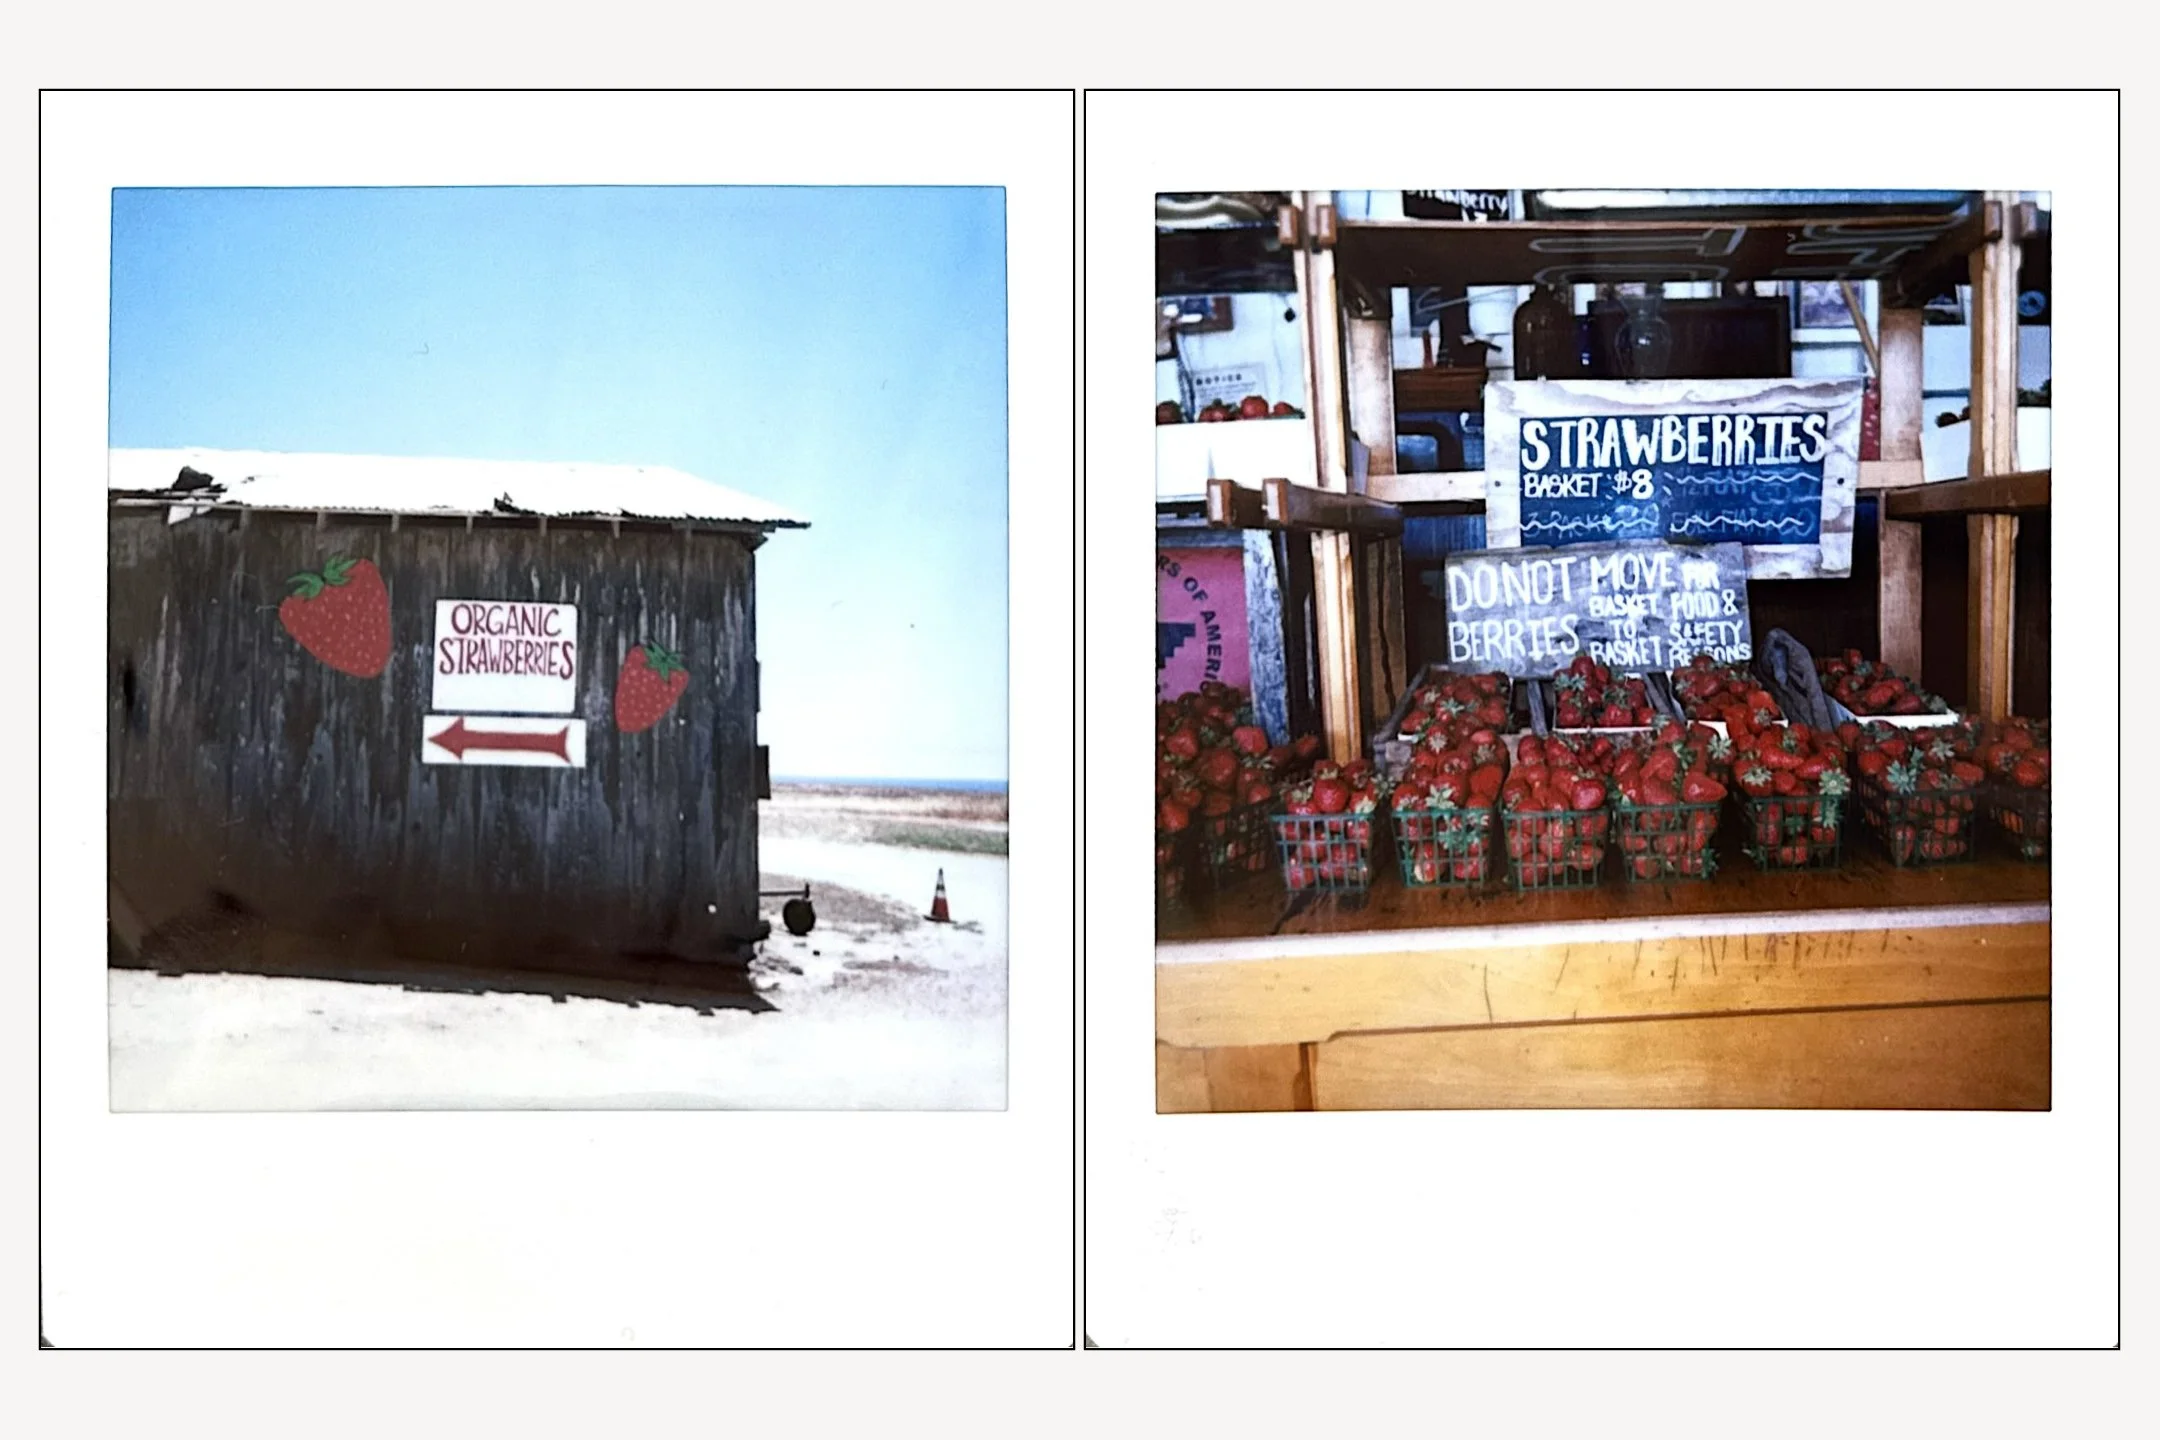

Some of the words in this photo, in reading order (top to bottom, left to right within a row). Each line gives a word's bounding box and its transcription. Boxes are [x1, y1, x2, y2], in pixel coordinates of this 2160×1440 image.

[1406, 190, 1508, 217] awberry
[1521, 414, 1827, 471] STRAWBERRIES
[1523, 472, 1603, 498] BASKET
[1612, 469, 1655, 500] $8
[1590, 552, 1676, 592] MOVE
[1183, 577, 1208, 600] OF
[451, 603, 562, 637] ORGANIC
[1588, 592, 1658, 619] BASKET
[1670, 591, 1719, 621] FOOD
[1448, 614, 1580, 662] BERRIES
[1609, 619, 1638, 640] TO
[1668, 620, 1743, 647] SAFETY
[439, 637, 574, 680] STRAWBERRIES
[1589, 635, 1661, 667] BASKET
